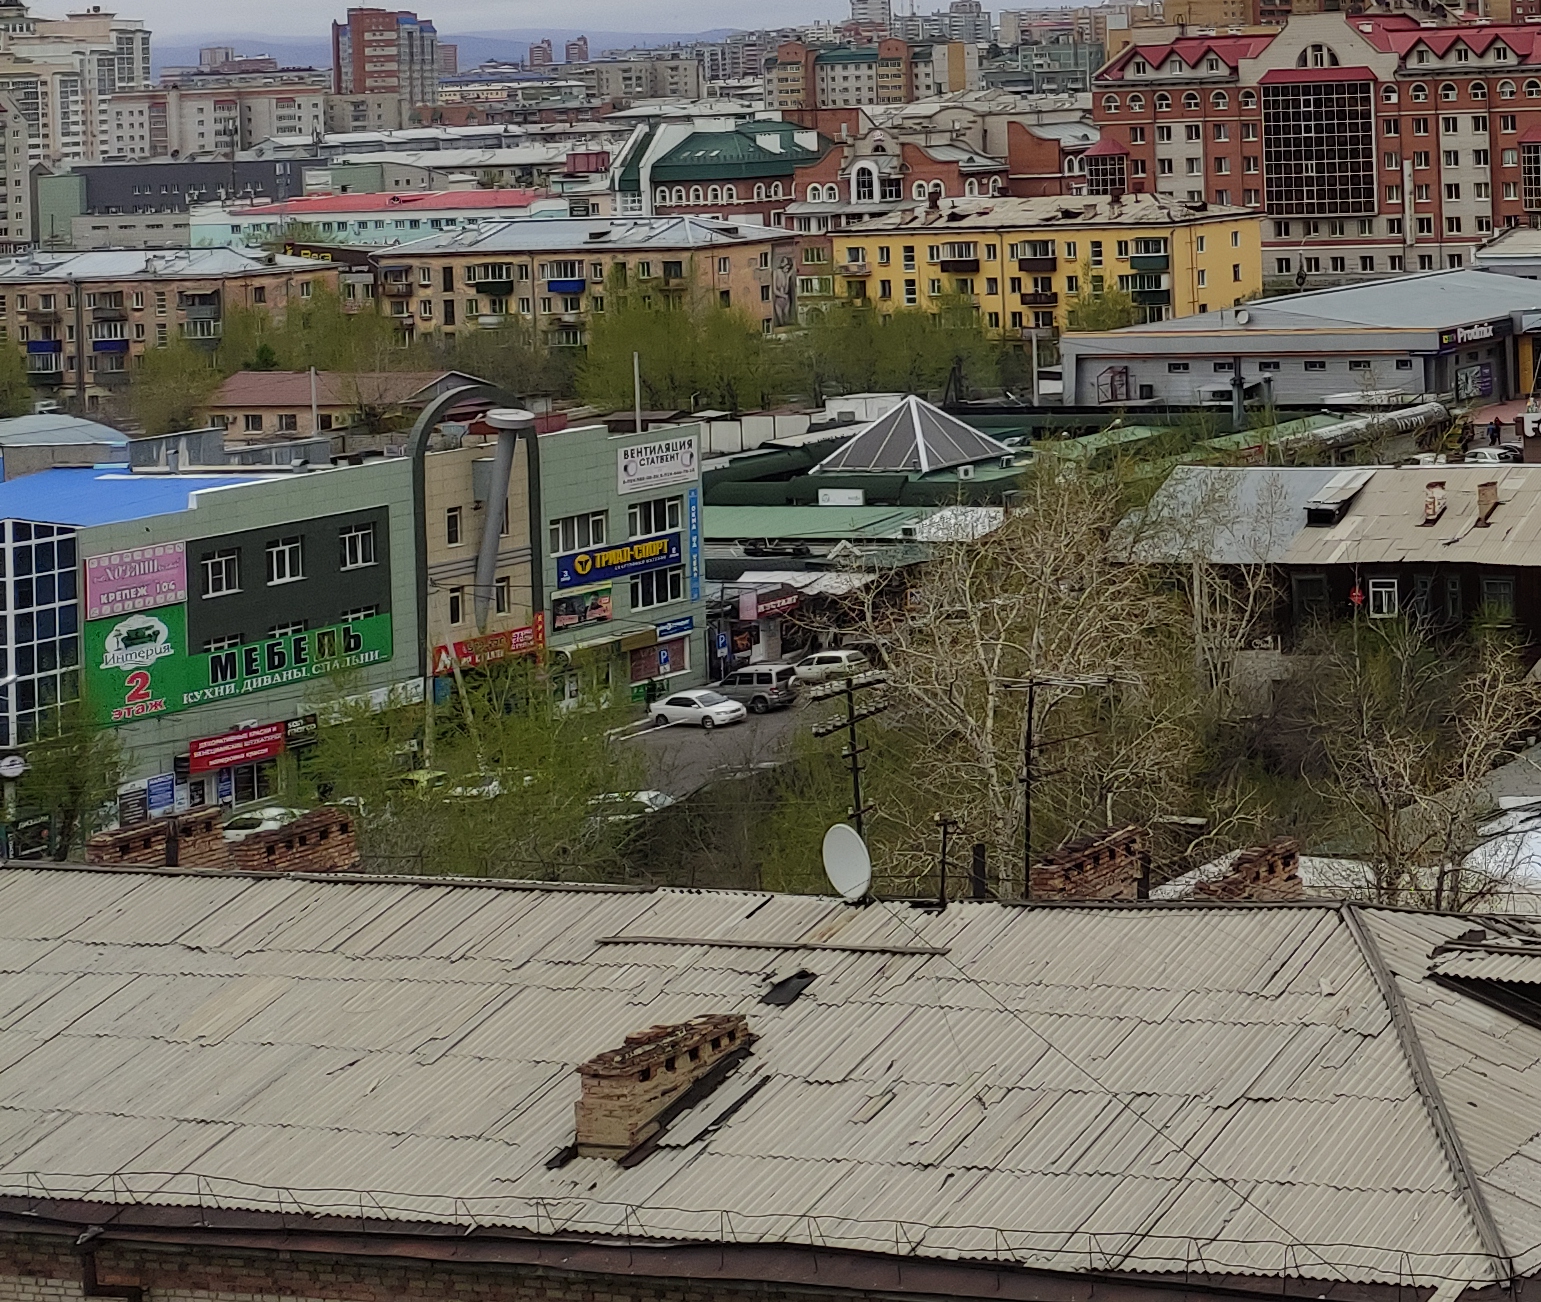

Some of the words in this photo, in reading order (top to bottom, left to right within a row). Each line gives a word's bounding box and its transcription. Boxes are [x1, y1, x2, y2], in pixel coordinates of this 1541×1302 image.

[623, 439, 693, 460] ВЕНТИЛЯЦИЯ
[639, 452, 680, 467] СТАТВЕНТ
[594, 539, 669, 569] ТРИАЛ-СПОРТ
[100, 586, 148, 604] КРЕПЕЖ
[103, 644, 170, 666] Интерия
[209, 624, 362, 686] МЕБЕЛЬ
[125, 670, 152, 705] 2
[182, 682, 240, 705] КУХНИ,
[241, 667, 310, 694] ДИВАНЫ,
[111, 698, 166, 720] этаж
